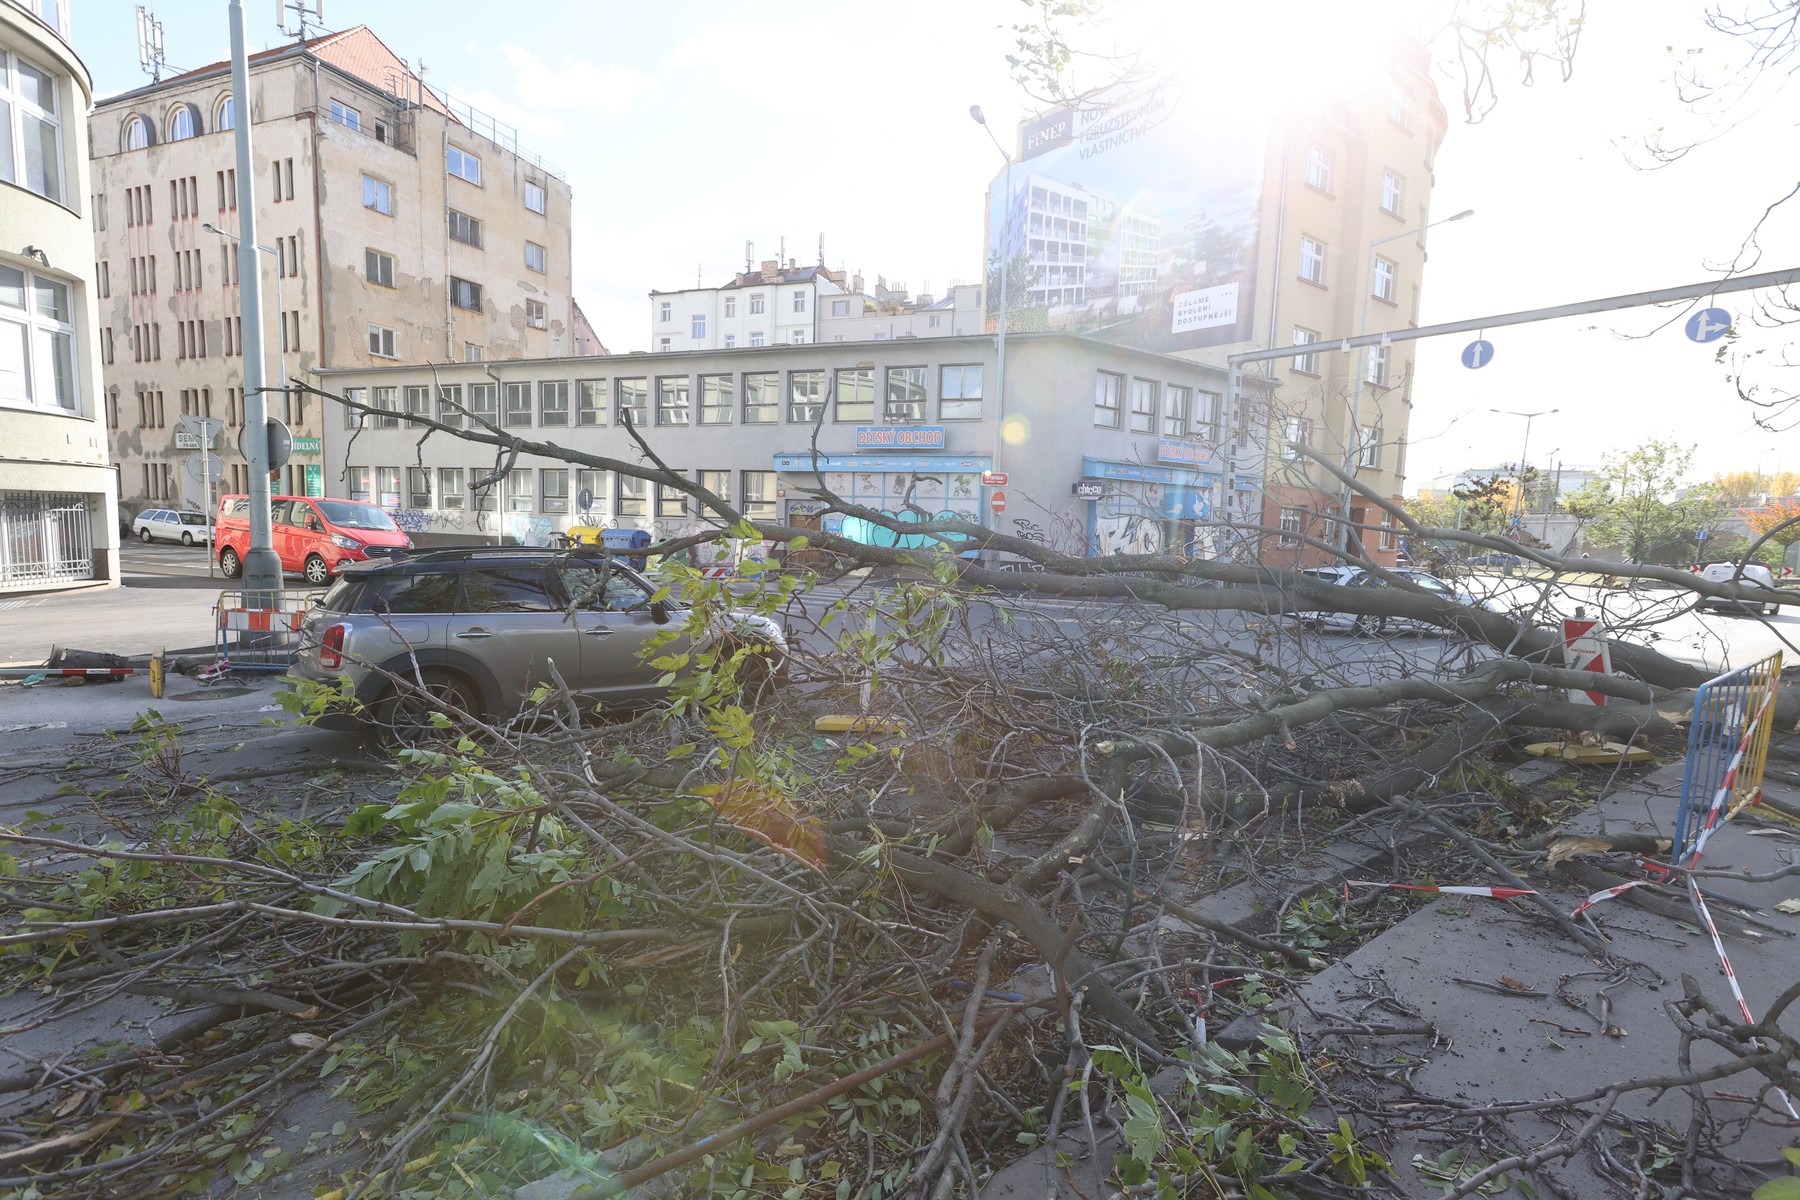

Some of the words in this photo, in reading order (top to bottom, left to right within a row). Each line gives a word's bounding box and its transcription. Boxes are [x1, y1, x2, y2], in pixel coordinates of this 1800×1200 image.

[1027, 121, 1067, 149] FINEP
[1079, 121, 1147, 161] VLASTNICTVÍ
[1177, 309, 1232, 325] DOSTUPNĚJŠÍ
[1178, 303, 1211, 316] BYDLENÍ
[858, 428, 895, 445] DĚTSKÝ
[897, 431, 942, 445] OBCHOD
[293, 440, 319, 450] ÍDELNA
[1160, 442, 1184, 459] DĚTSKÝ
[1077, 482, 1102, 494] chicco
